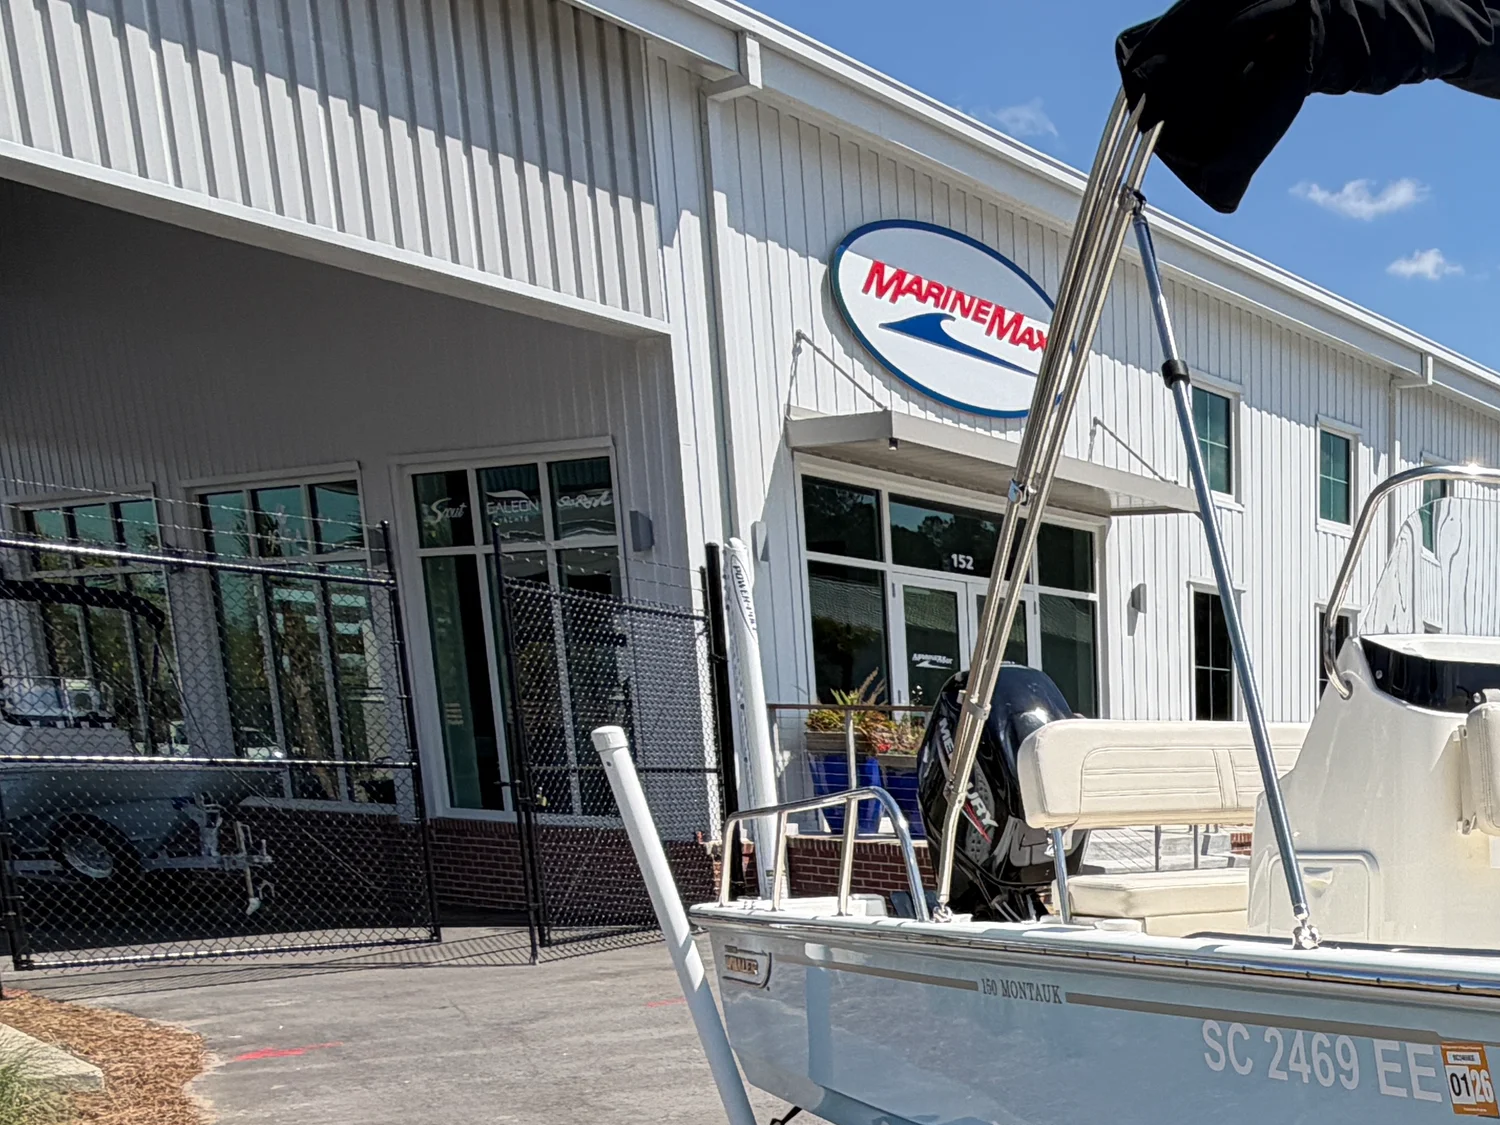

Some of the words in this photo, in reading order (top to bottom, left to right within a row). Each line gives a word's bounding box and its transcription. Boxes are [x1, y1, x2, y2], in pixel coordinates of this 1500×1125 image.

[951, 553, 974, 570] 152
[939, 717, 999, 828] MEURY
[981, 978, 998, 996] 150
[1000, 979, 1063, 1004] MONTAUK
[1202, 1019, 1253, 1075] SC
[1264, 1027, 1360, 1090] 2469
[1373, 1039, 1443, 1102] EE
[1450, 1072, 1471, 1097] 01
[1470, 1069, 1494, 1103] 26
